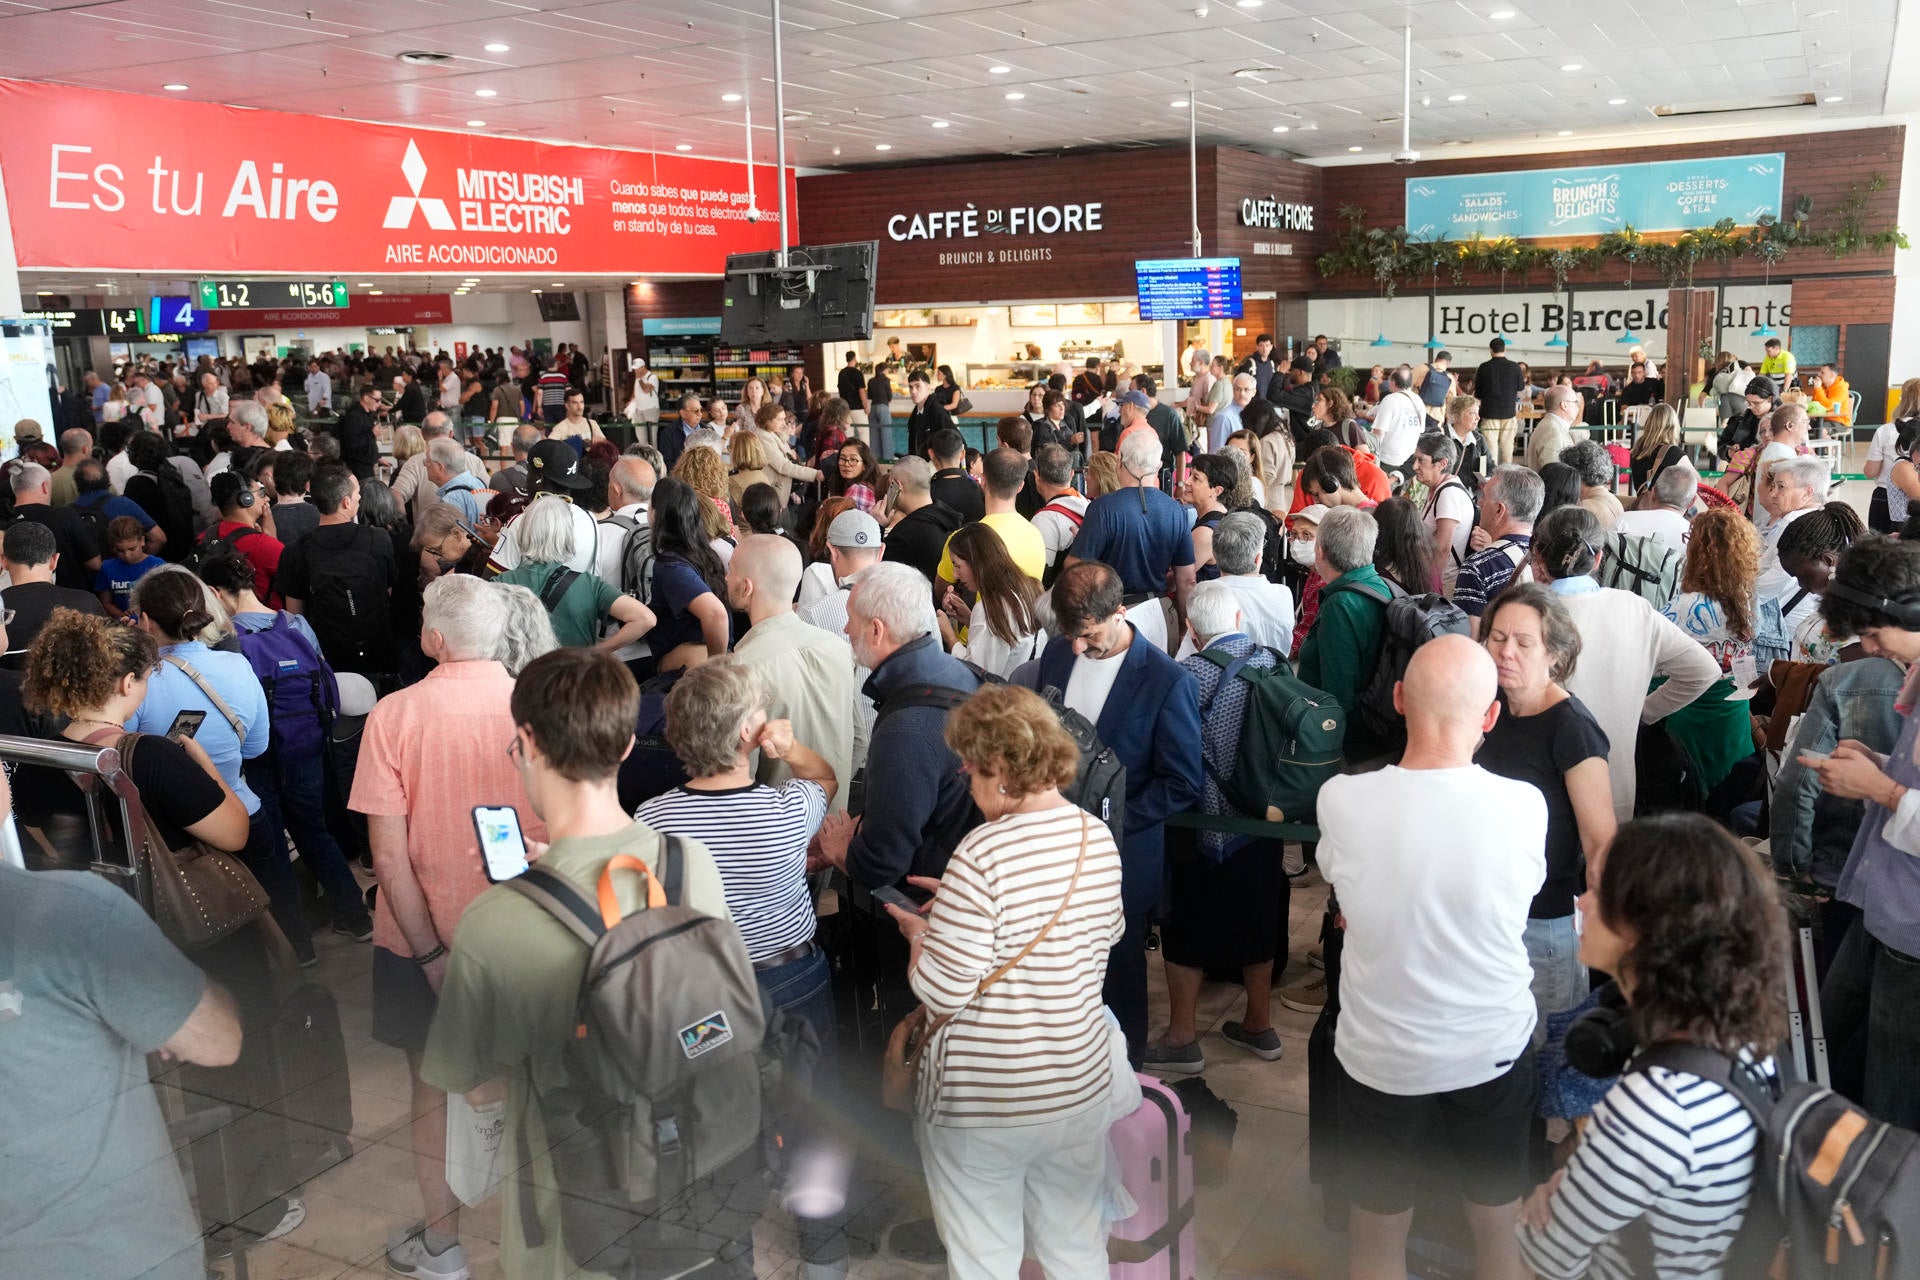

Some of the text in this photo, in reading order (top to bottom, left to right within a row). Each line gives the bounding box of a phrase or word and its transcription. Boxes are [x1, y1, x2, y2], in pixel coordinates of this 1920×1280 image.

[49, 143, 339, 223] Es tu Aire
[456, 168, 585, 205] MITSUBISHI
[610, 179, 756, 206] Cuando sabes que puede gast
[1552, 183, 1620, 204] BRUNCH &
[1669, 178, 1727, 193] DESSERTS
[1465, 197, 1502, 208] SALADS
[1555, 198, 1616, 219] DELIGHTS
[1677, 194, 1718, 206] COFFEE
[1682, 204, 1712, 214] & TEA
[459, 200, 572, 235] ELECTRIC
[612, 200, 780, 223] menos que todos los electrodsticos
[887, 202, 1103, 242] CAFFÈ DI FIORE
[1242, 194, 1276, 228] CAFFÈ
[1285, 203, 1314, 231] FIORE
[1452, 211, 1518, 223] SANDWICHES
[613, 219, 718, 237] en stand by de tu casa.
[384, 244, 558, 265] AIRE ACONDICIONADO
[939, 248, 1052, 266] BRUNCH & DELIGHTS
[174, 302, 194, 327] 4
[1439, 303, 1531, 334] Hotel
[1715, 300, 1792, 328] ants
